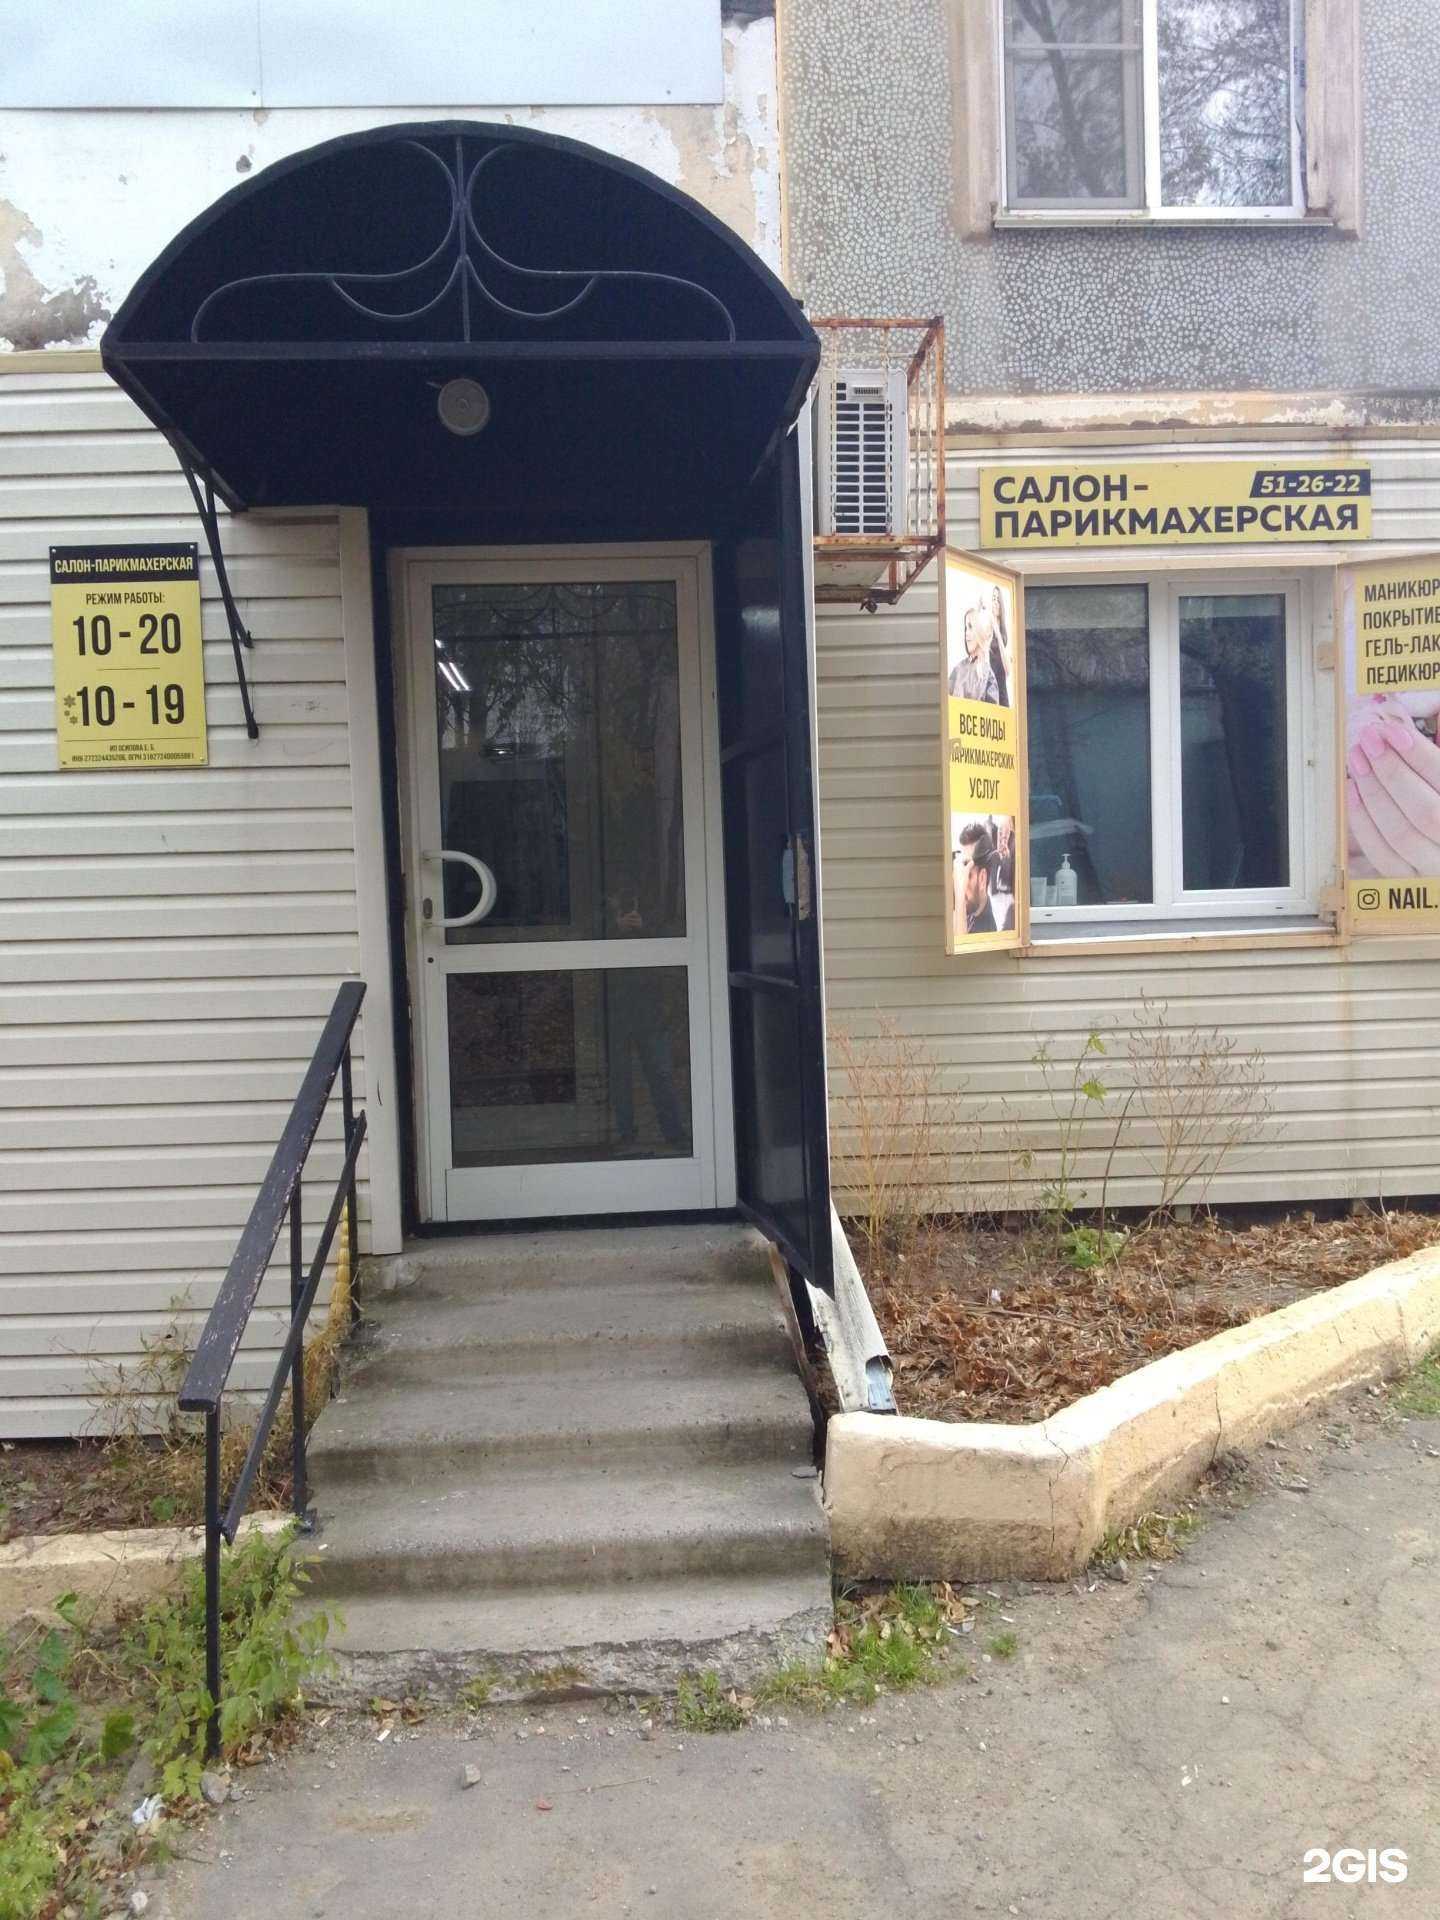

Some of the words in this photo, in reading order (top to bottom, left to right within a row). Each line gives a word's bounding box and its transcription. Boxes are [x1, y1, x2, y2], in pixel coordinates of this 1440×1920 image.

[993, 474, 1149, 504] САЛОН-
[1261, 475, 1361, 494] 51-26-22
[994, 503, 1359, 538] ПАРИКМАХЕРСКАЯ
[54, 556, 194, 574] САЛОН-ПАРИКМАХЕРСКАЯ
[86, 592, 122, 605] РЕЖИМ
[124, 591, 166, 604] РАБОТЫ:
[1364, 579, 1440, 602] МАНИКЮР
[73, 615, 112, 656] 10
[138, 613, 181, 655] 20
[1366, 635, 1440, 658] ГЕЛЬ-ЛАК
[1367, 662, 1440, 685] ПЕДИКЮР
[76, 685, 116, 727] 10
[146, 684, 185, 725] 19
[960, 713, 978, 736] ВСЕ
[980, 716, 1006, 742] ВИДЫ
[969, 777, 1001, 800] УСЛУГ
[1389, 887, 1439, 910] NAIL.
